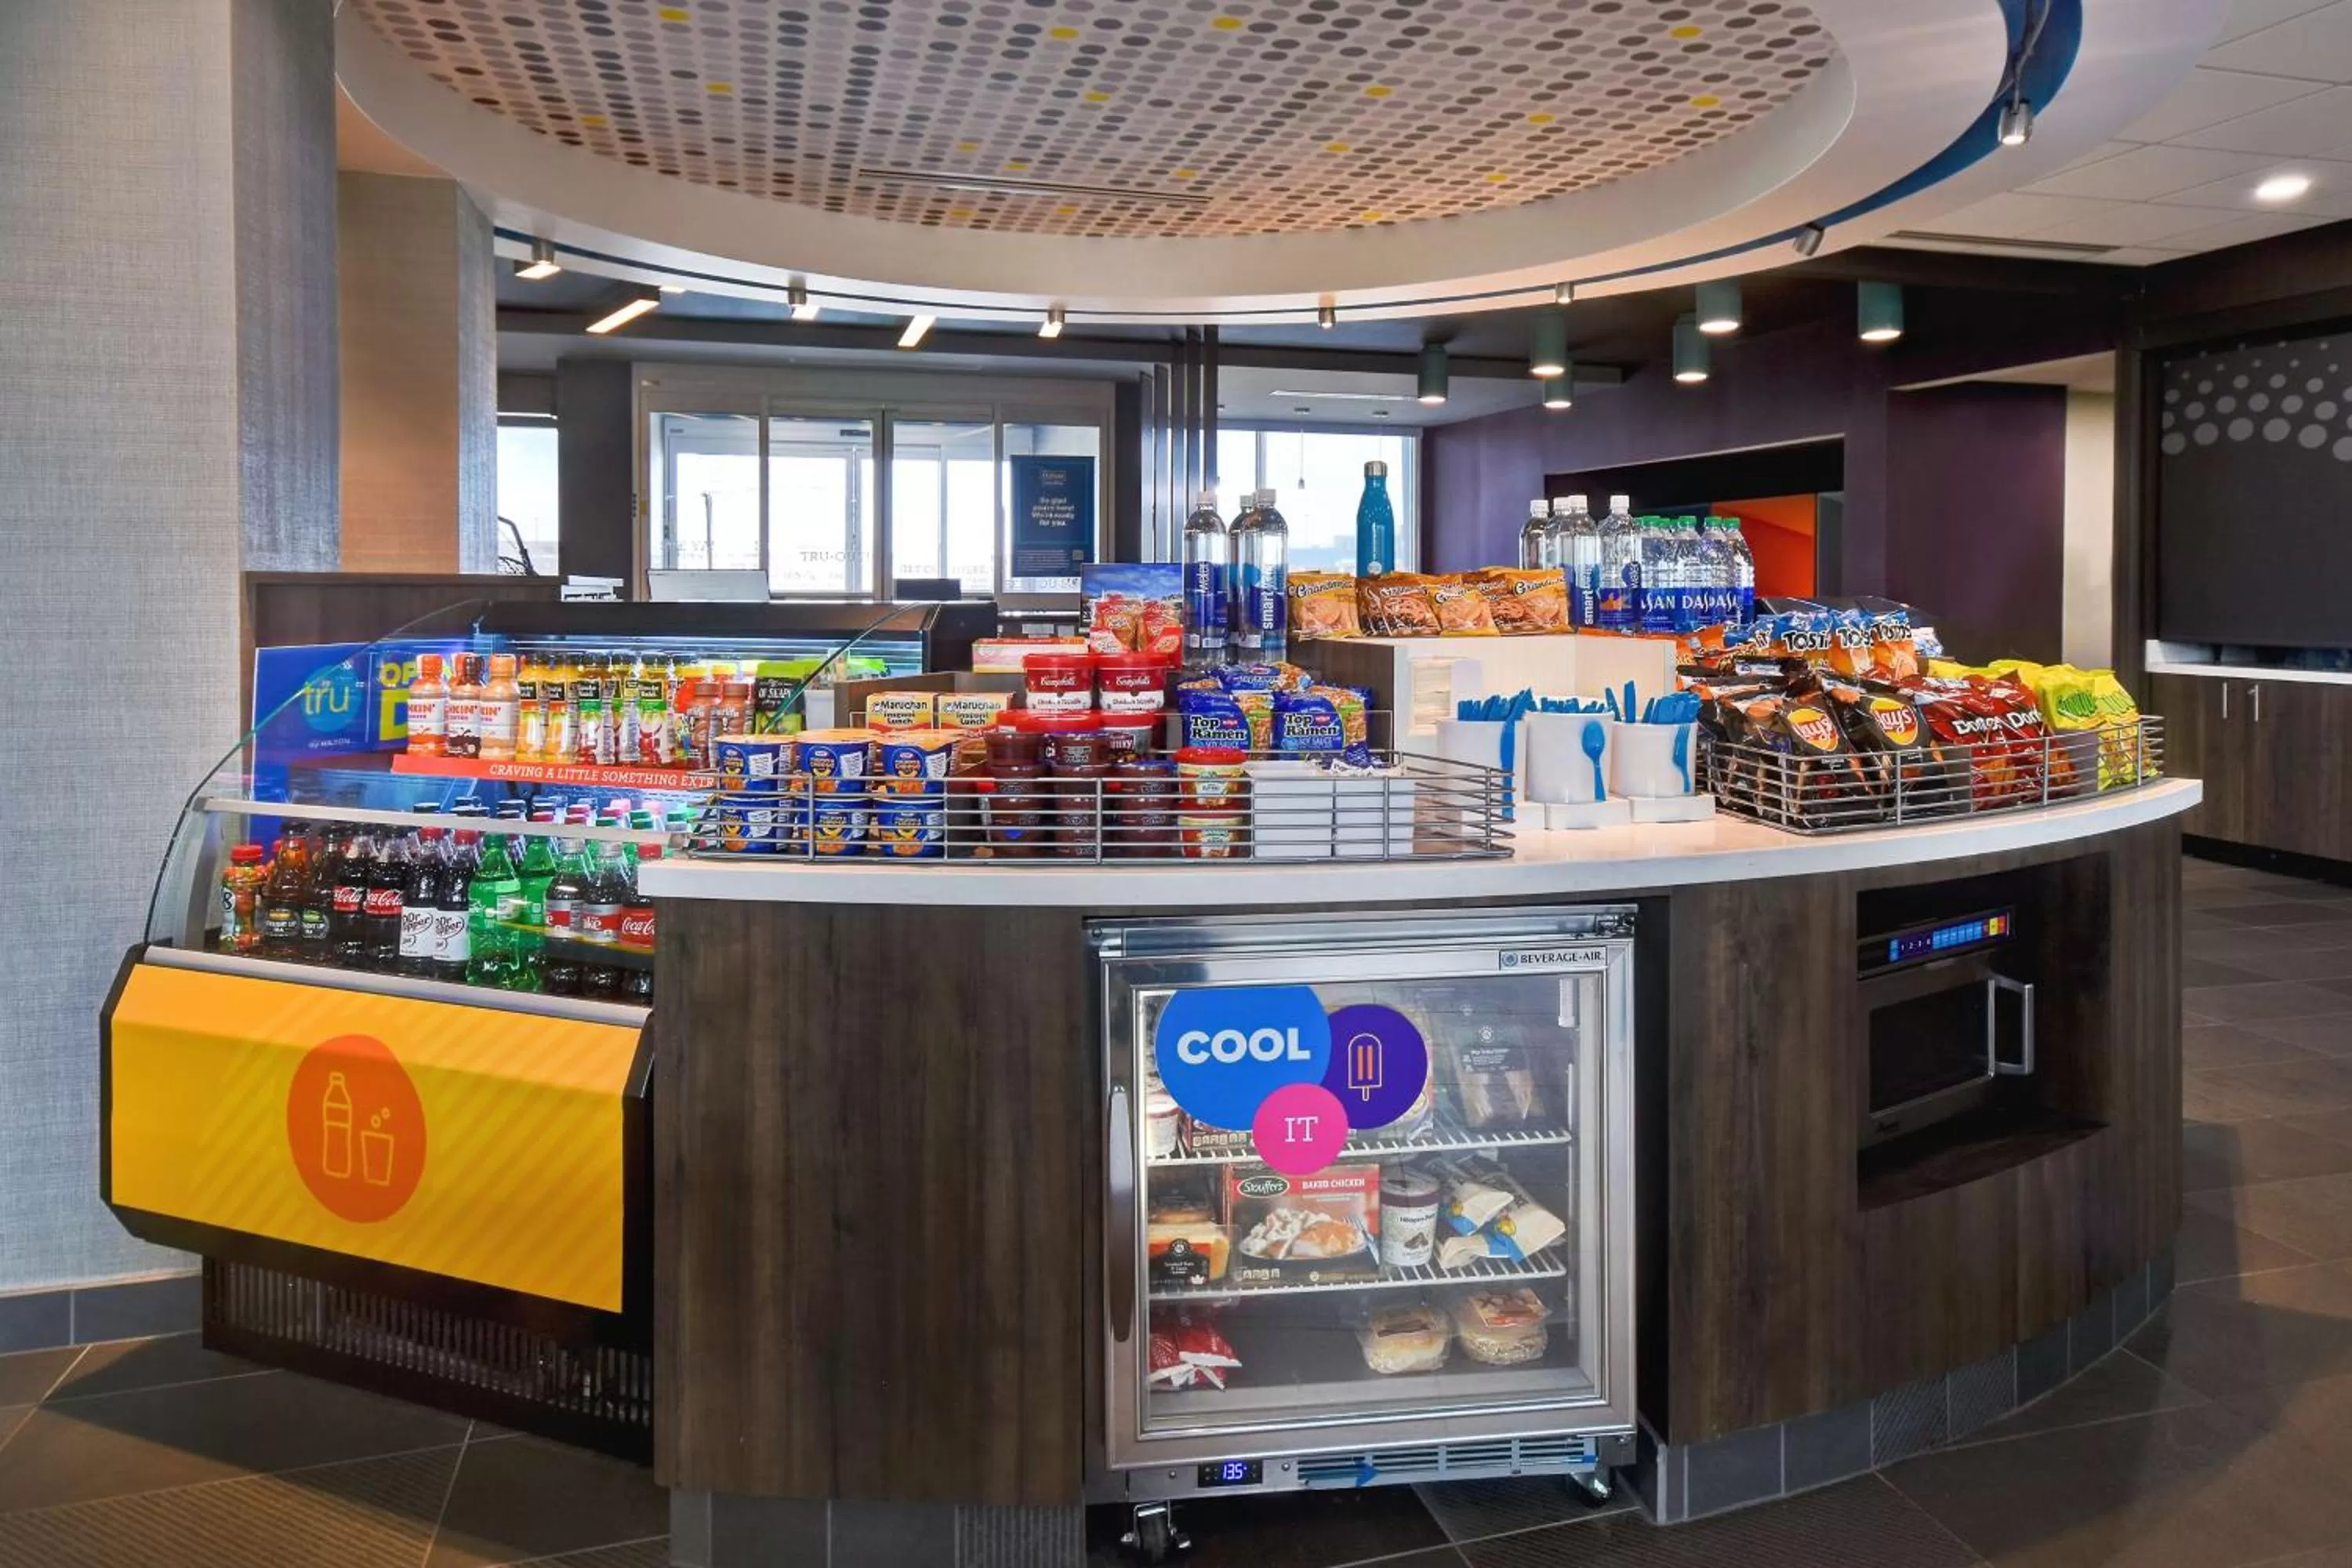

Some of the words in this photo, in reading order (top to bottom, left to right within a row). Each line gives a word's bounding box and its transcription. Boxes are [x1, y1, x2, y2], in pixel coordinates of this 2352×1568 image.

[880, 700, 927, 710] Maruchan
[1191, 715, 1219, 731] Top
[1284, 713, 1312, 729] Top
[1877, 706, 1915, 734] Lay's
[1191, 728, 1247, 740] Ramen
[1284, 725, 1338, 737] Ramen
[489, 764, 543, 777] CRAVING
[546, 767, 555, 779] A
[557, 768, 598, 782] LITTLE
[601, 770, 678, 786] SOMETHING
[680, 775, 715, 789] EXTR
[1178, 1028, 1311, 1065] COOL
[1285, 1116, 1319, 1143] IT
[1302, 1180, 1329, 1189] BAKED
[1330, 1178, 1366, 1189] CHICKEN
